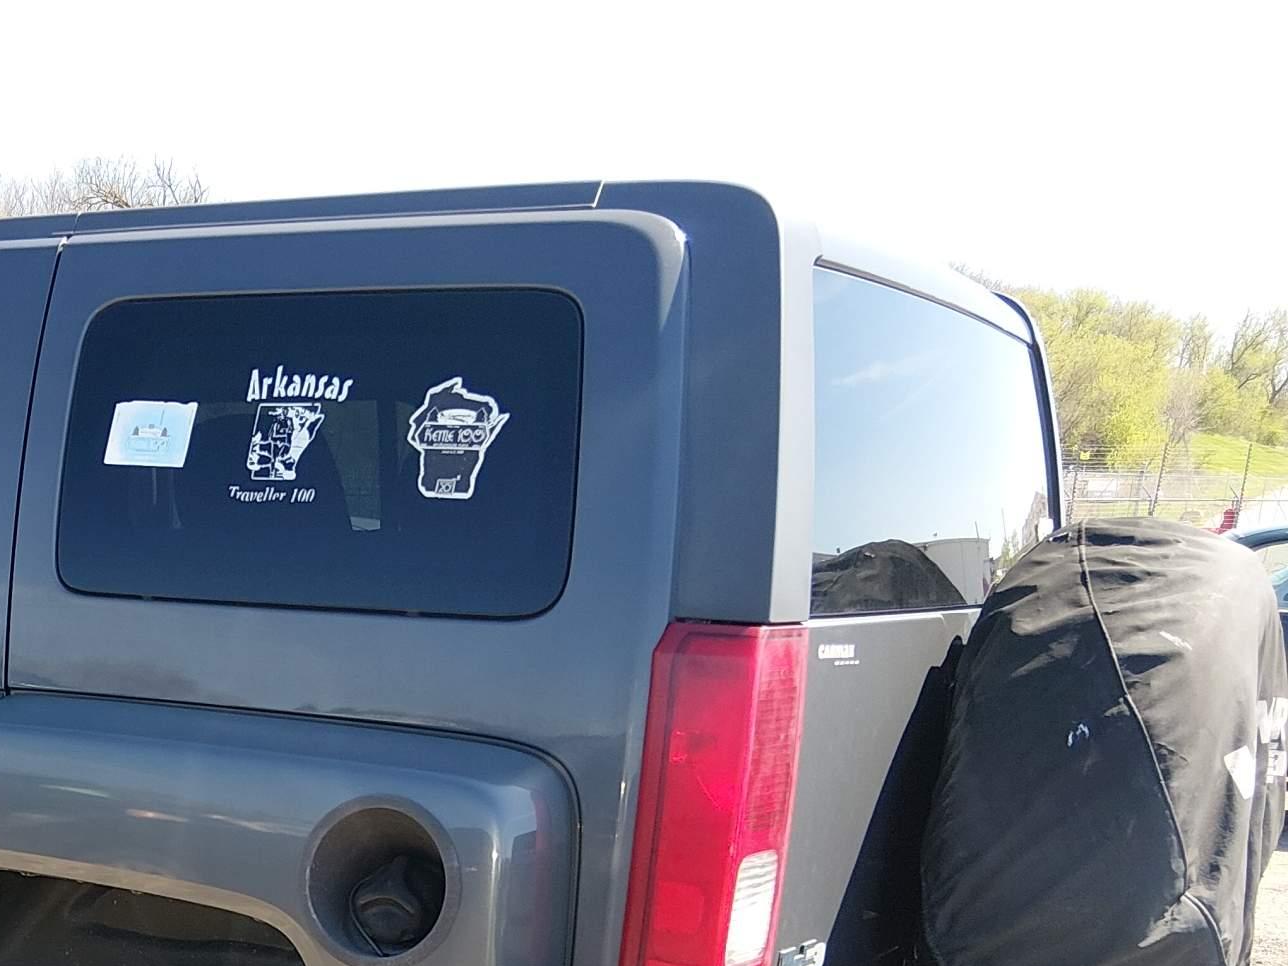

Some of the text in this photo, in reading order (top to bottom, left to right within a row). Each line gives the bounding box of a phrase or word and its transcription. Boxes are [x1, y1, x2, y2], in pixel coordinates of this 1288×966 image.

[246, 365, 354, 402] Arkansas
[457, 428, 486, 443] 100
[228, 486, 316, 503] Traveller 100
